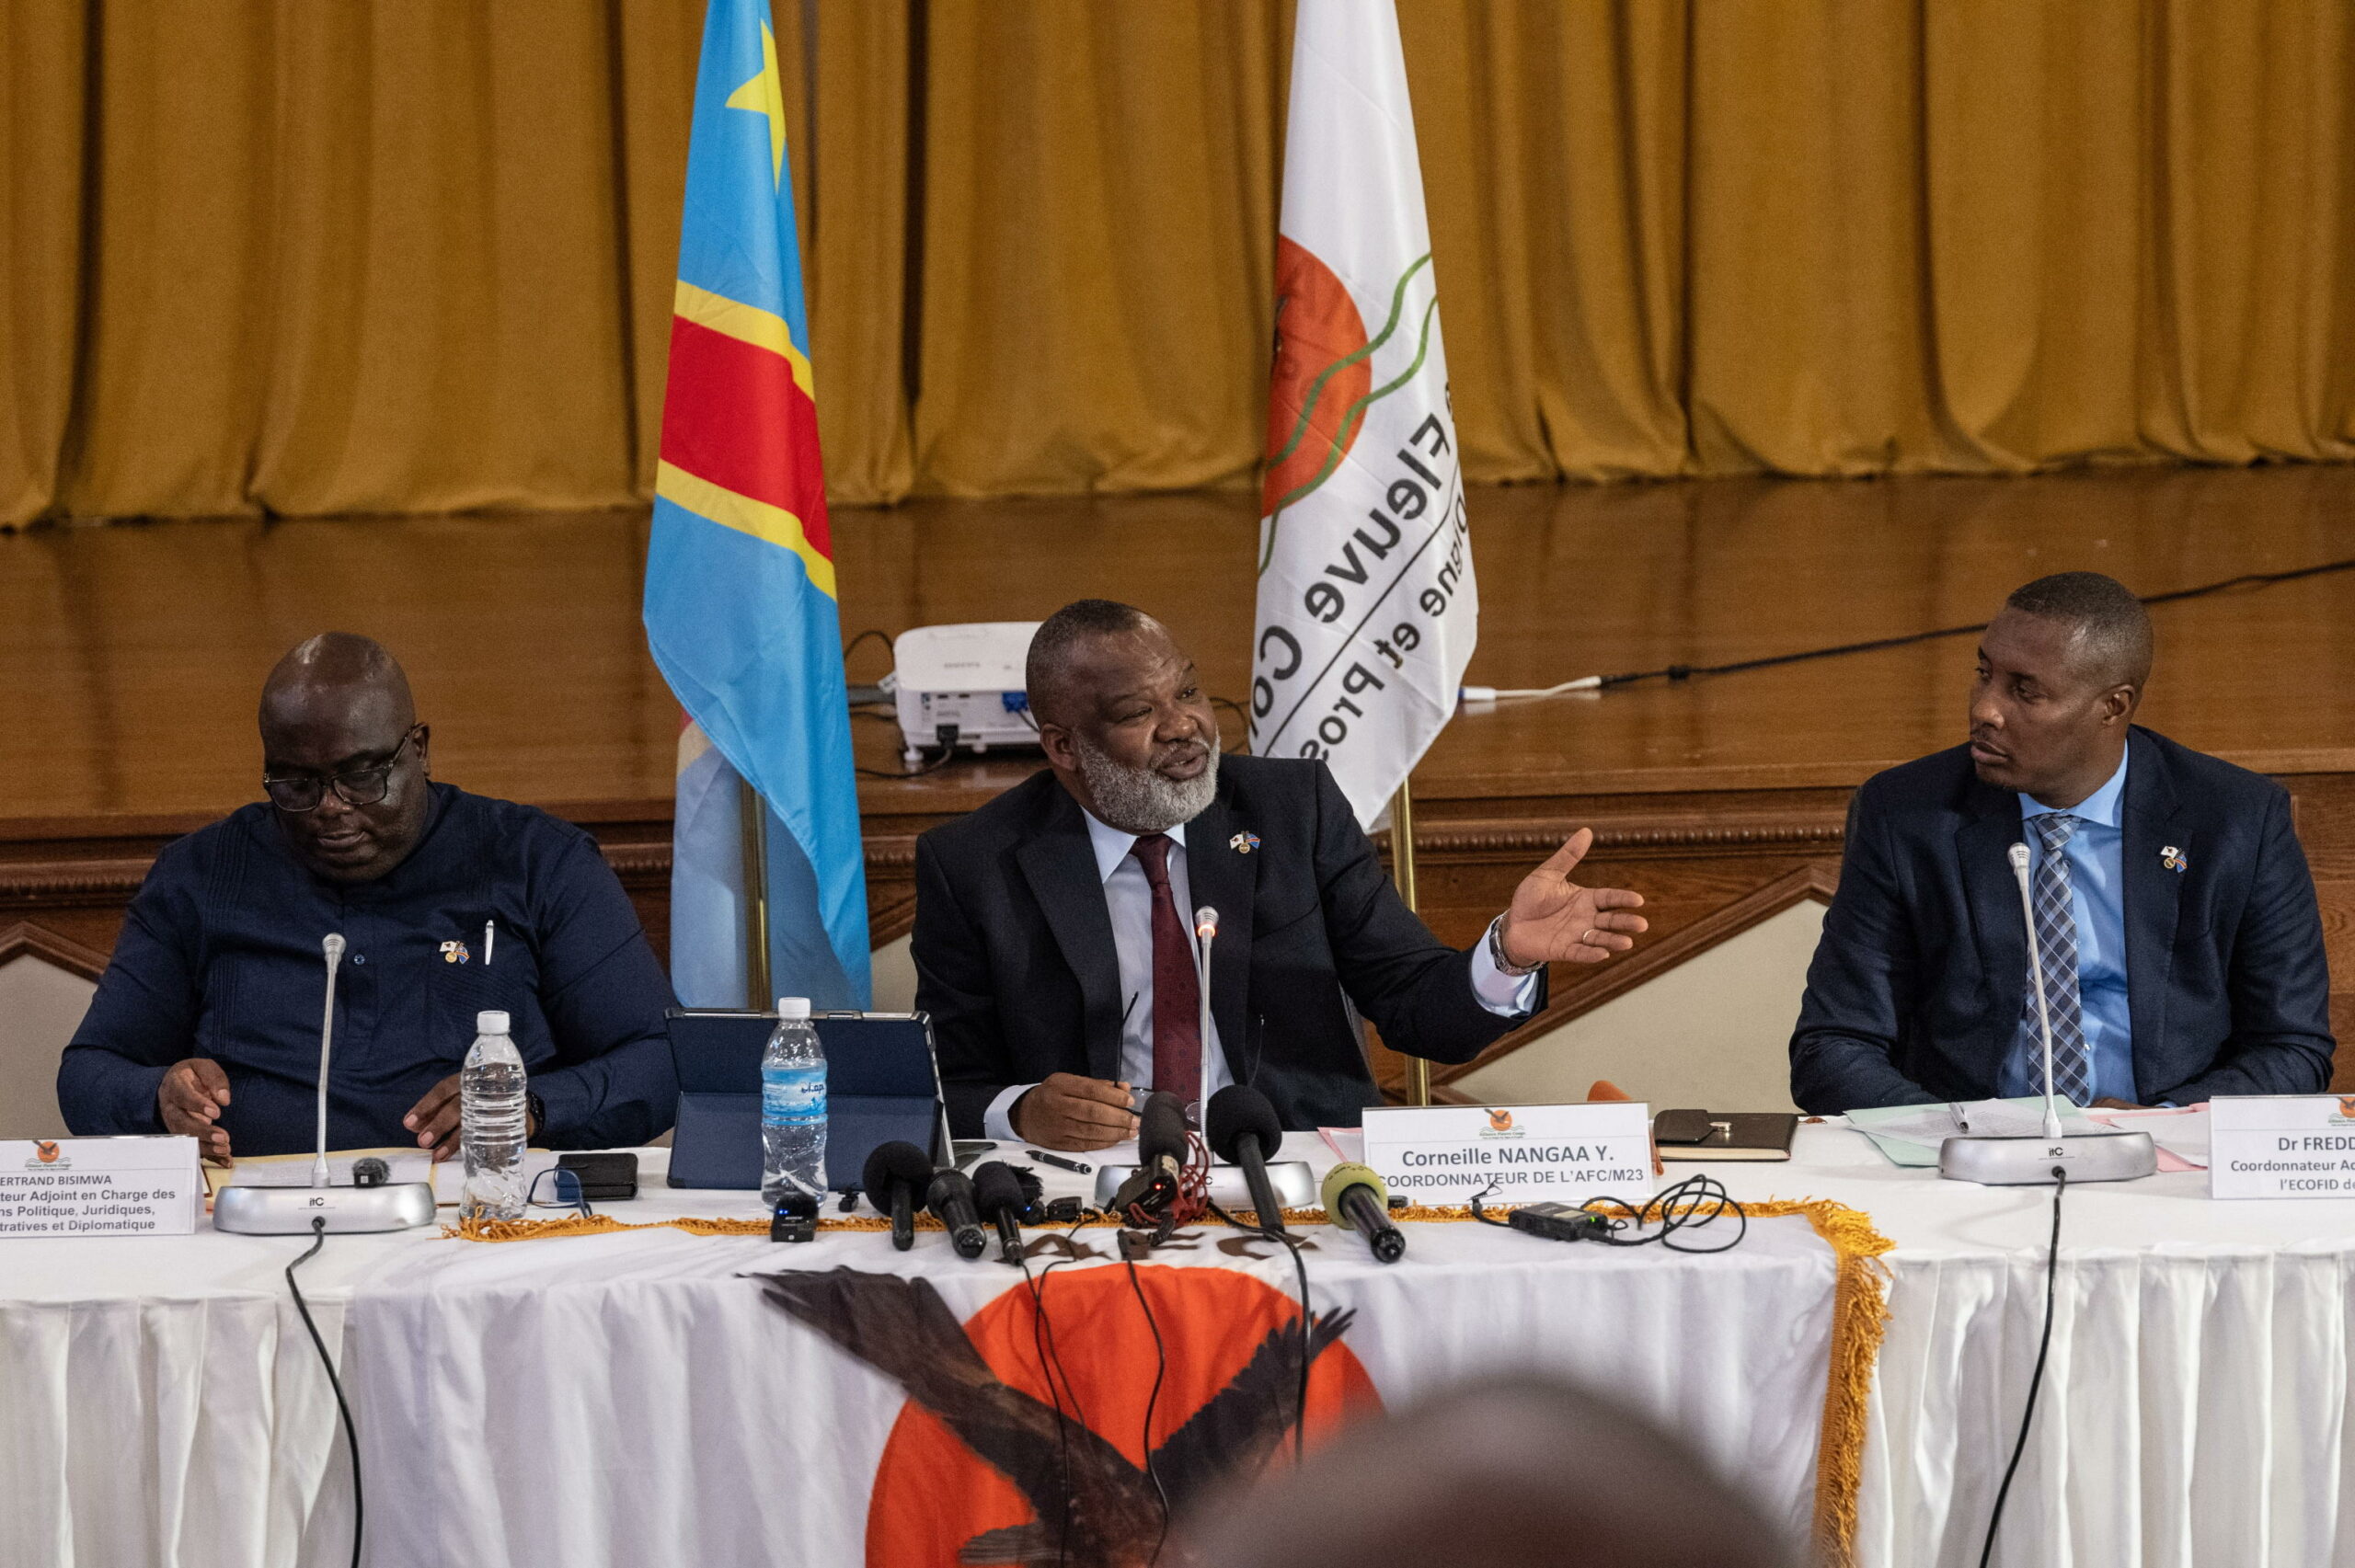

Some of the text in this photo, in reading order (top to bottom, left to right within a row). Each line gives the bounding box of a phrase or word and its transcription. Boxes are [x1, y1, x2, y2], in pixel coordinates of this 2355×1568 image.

[2278, 1137, 2298, 1150] Dr
[1402, 1145, 1614, 1167] Corneille NANGAA Y.
[2230, 1160, 2337, 1172] Coordonnateur
[58, 1175, 112, 1185] BISIMWA
[1533, 1171, 1556, 1185] DE
[1560, 1169, 1644, 1184] L’AFC/M23
[2280, 1179, 2339, 1191] l’ECOFID
[29, 1190, 77, 1204] Adjoint
[80, 1191, 98, 1200] en
[100, 1189, 148, 1203] Charge
[152, 1189, 176, 1199] des
[17, 1206, 79, 1219] Politique,
[82, 1204, 155, 1217] Juridiques,
[52, 1221, 64, 1231] et
[68, 1219, 155, 1232] Diplomatique
